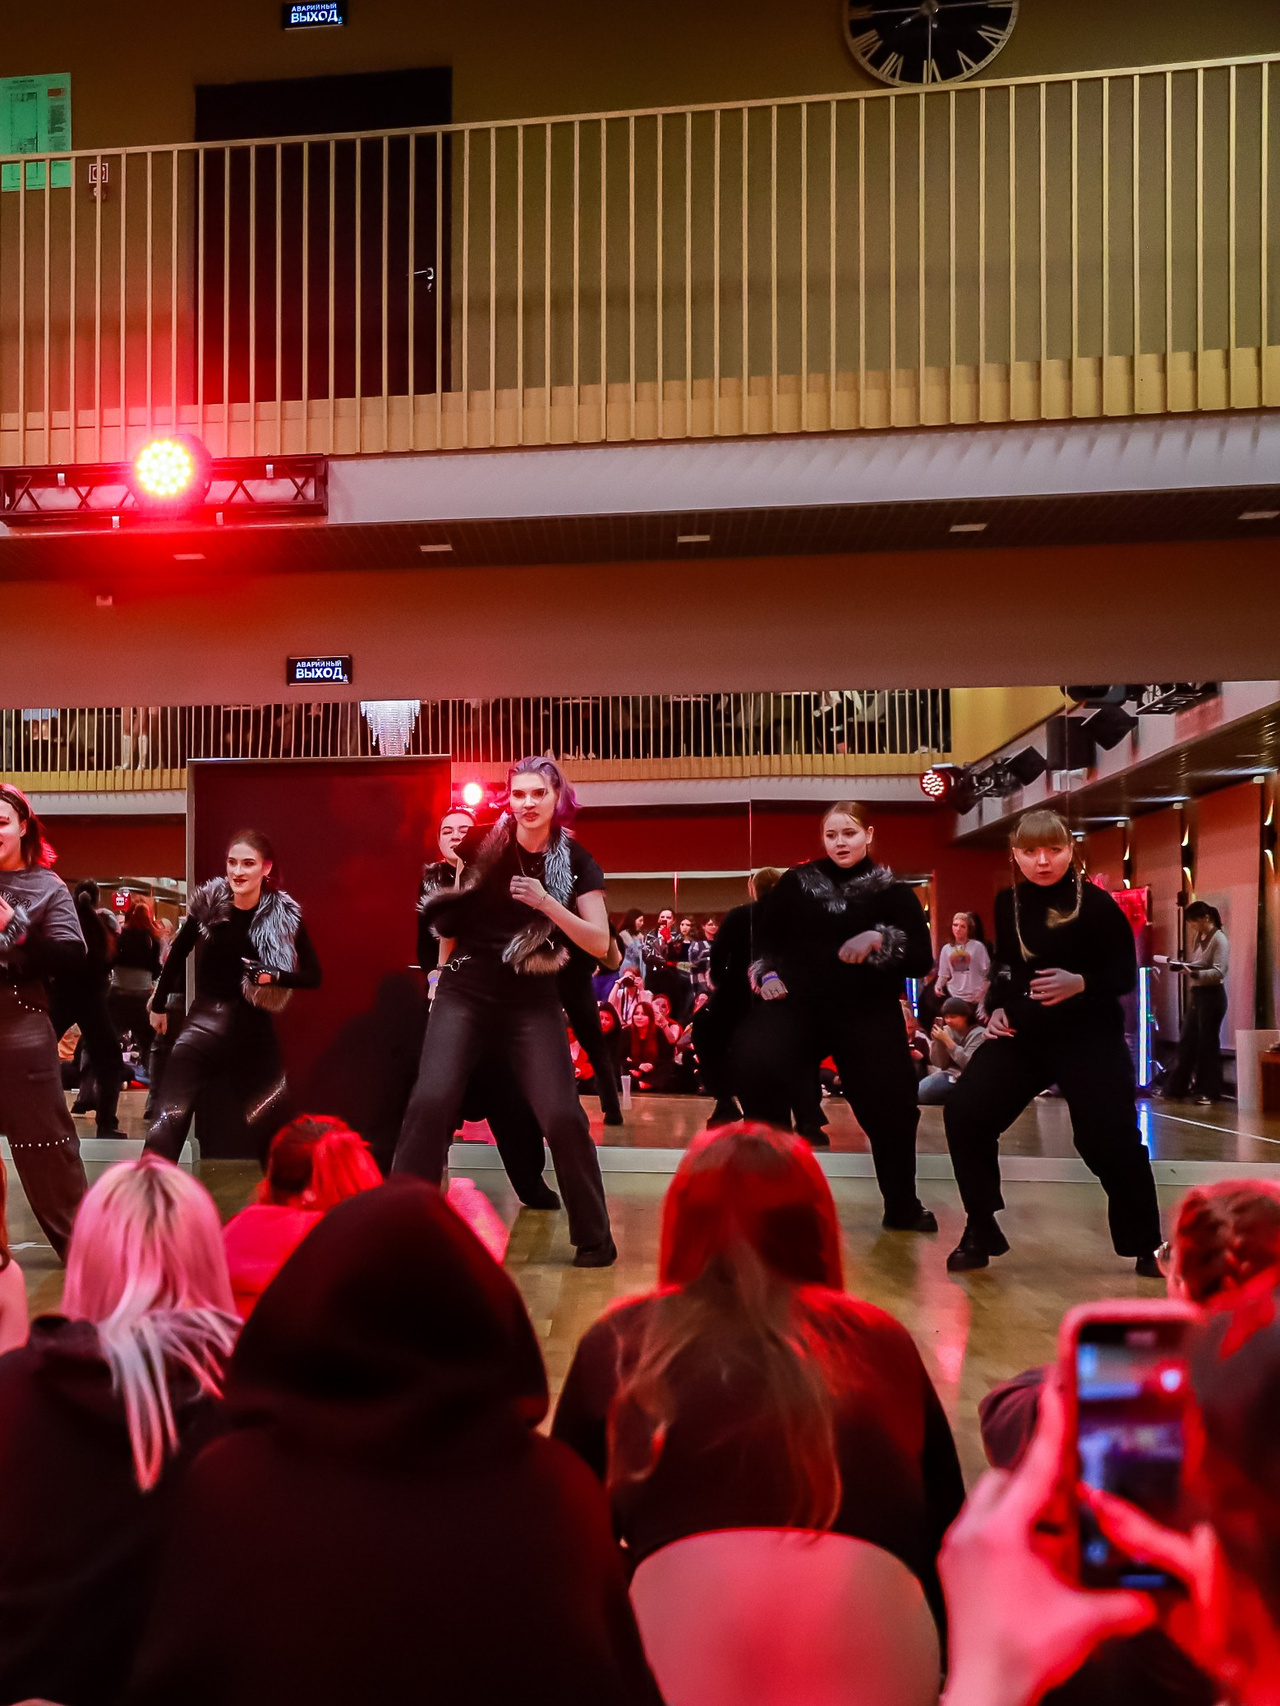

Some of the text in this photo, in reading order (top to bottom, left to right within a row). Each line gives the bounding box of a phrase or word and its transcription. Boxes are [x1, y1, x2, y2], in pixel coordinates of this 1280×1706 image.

[291, 2, 337, 12] АВАРИЙНЫЙ
[291, 10, 338, 23] ВЫХОД
[296, 660, 342, 668] АВАРИЙНЫЙ
[295, 667, 343, 680] ВЫХОД
